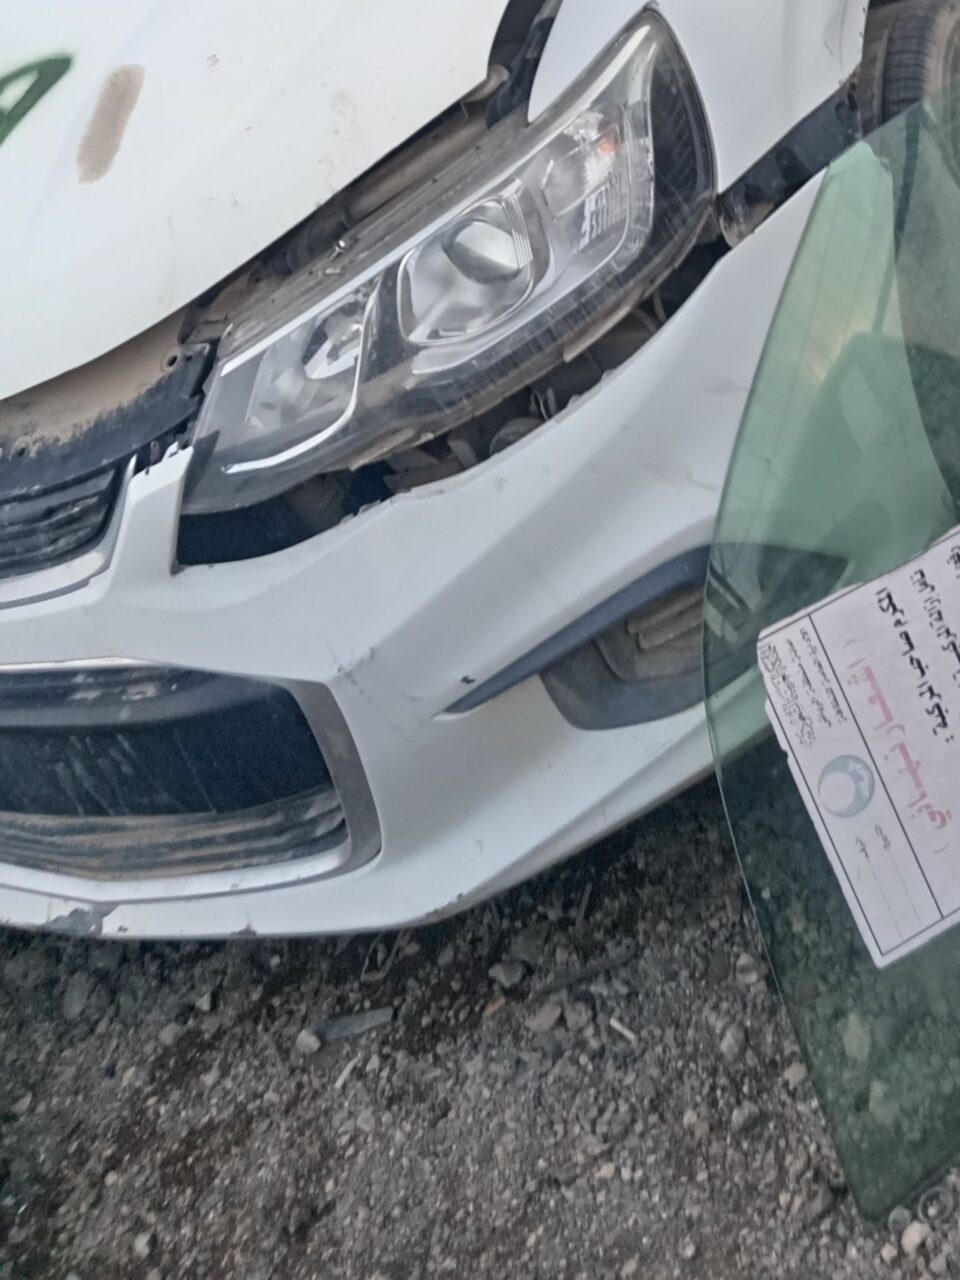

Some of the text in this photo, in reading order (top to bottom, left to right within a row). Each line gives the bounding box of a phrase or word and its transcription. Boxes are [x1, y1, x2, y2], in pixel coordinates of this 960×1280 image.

[873, 585, 909, 629] المكرم
[897, 628, 930, 680] صاحب
[915, 679, 950, 737] المركبة
